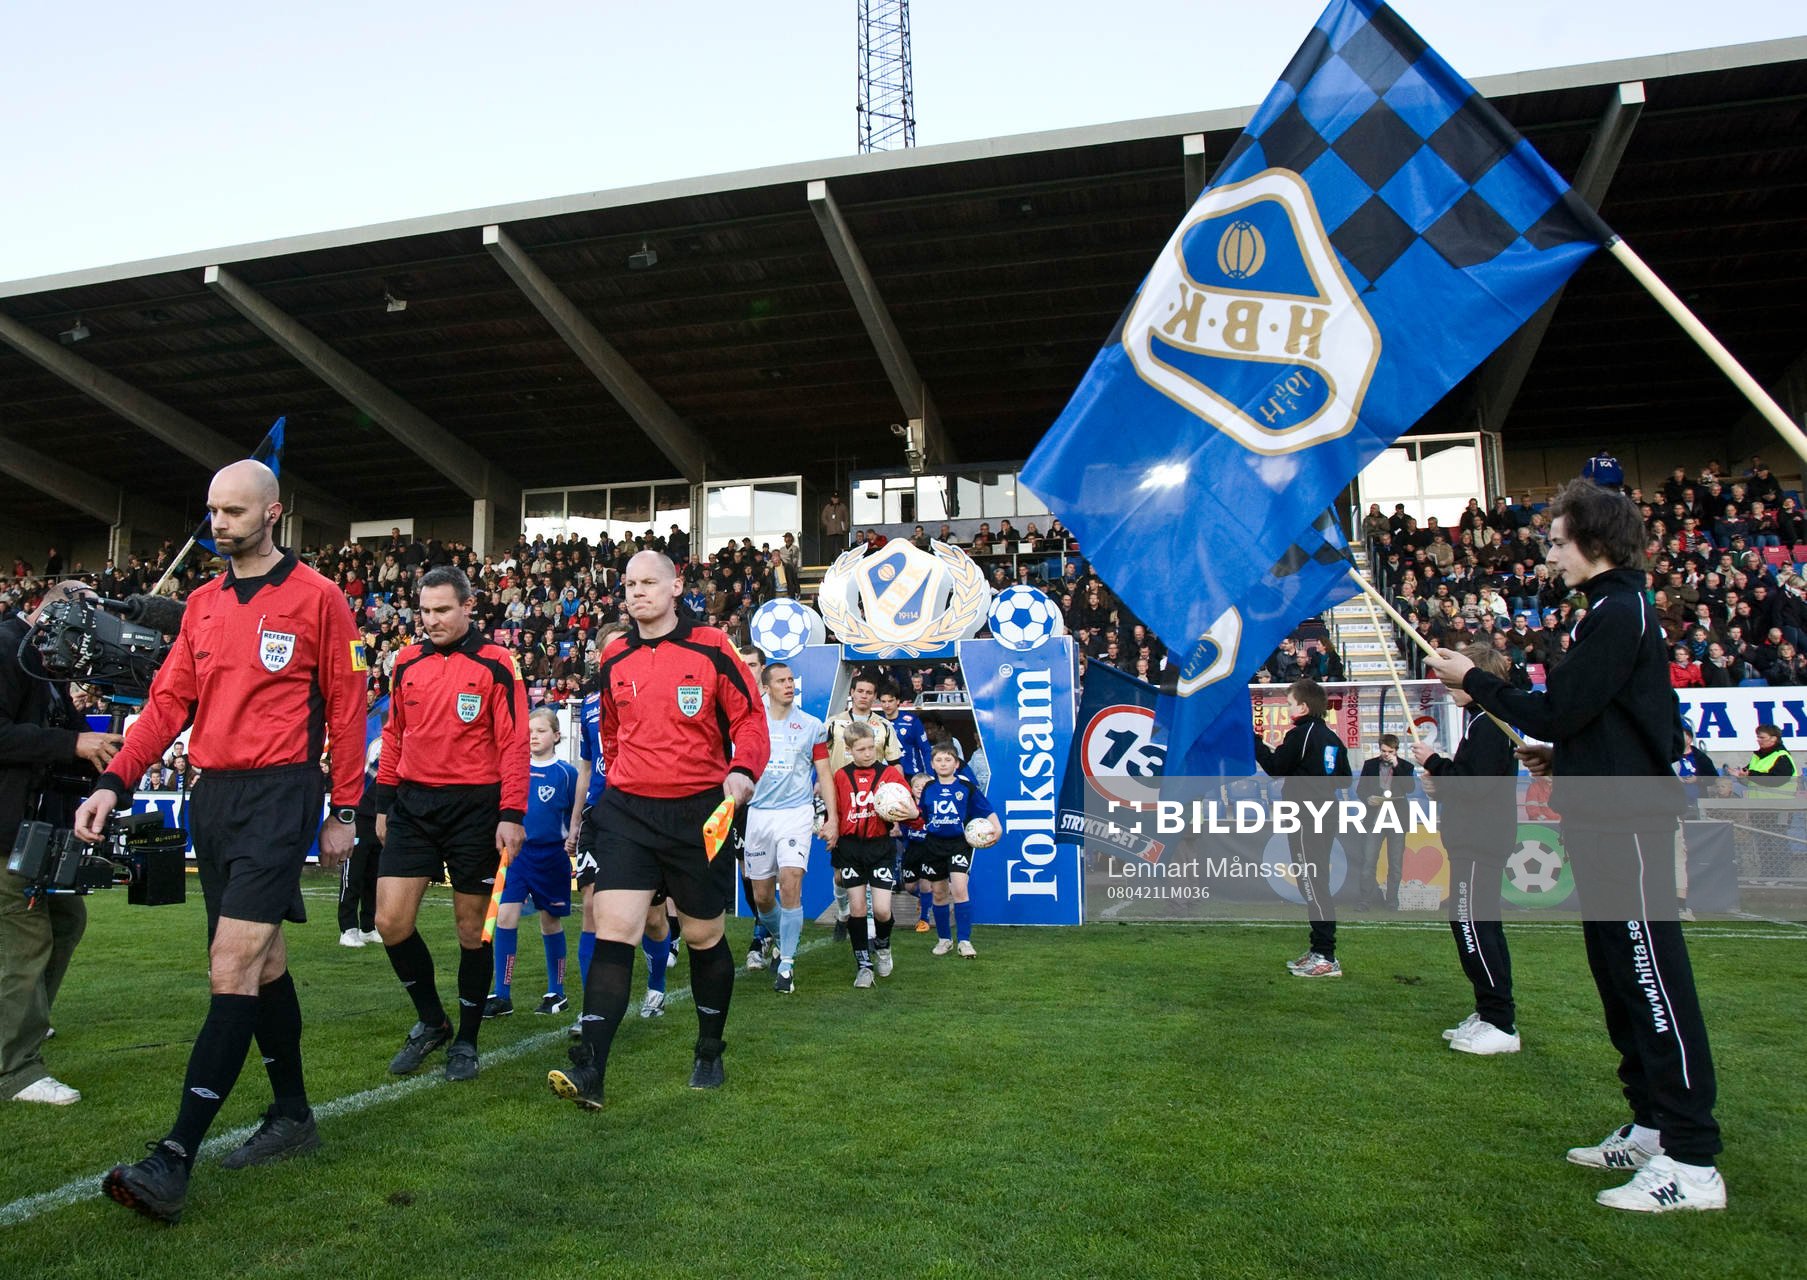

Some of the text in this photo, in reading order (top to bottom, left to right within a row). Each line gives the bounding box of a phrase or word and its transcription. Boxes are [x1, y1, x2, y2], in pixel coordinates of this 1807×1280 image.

[264, 632, 294, 642] REFEREE
[265, 654, 285, 663] FIFA
[1099, 729, 1168, 789] 13
[1005, 667, 1058, 902] Folksam
[850, 790, 875, 808] ICA
[933, 800, 959, 815] ICA
[952, 854, 969, 867] ICA
[873, 867, 893, 879] ICA
[1457, 881, 1476, 954] www.hitta.se
[1627, 920, 1669, 1034] www.hitta.se
